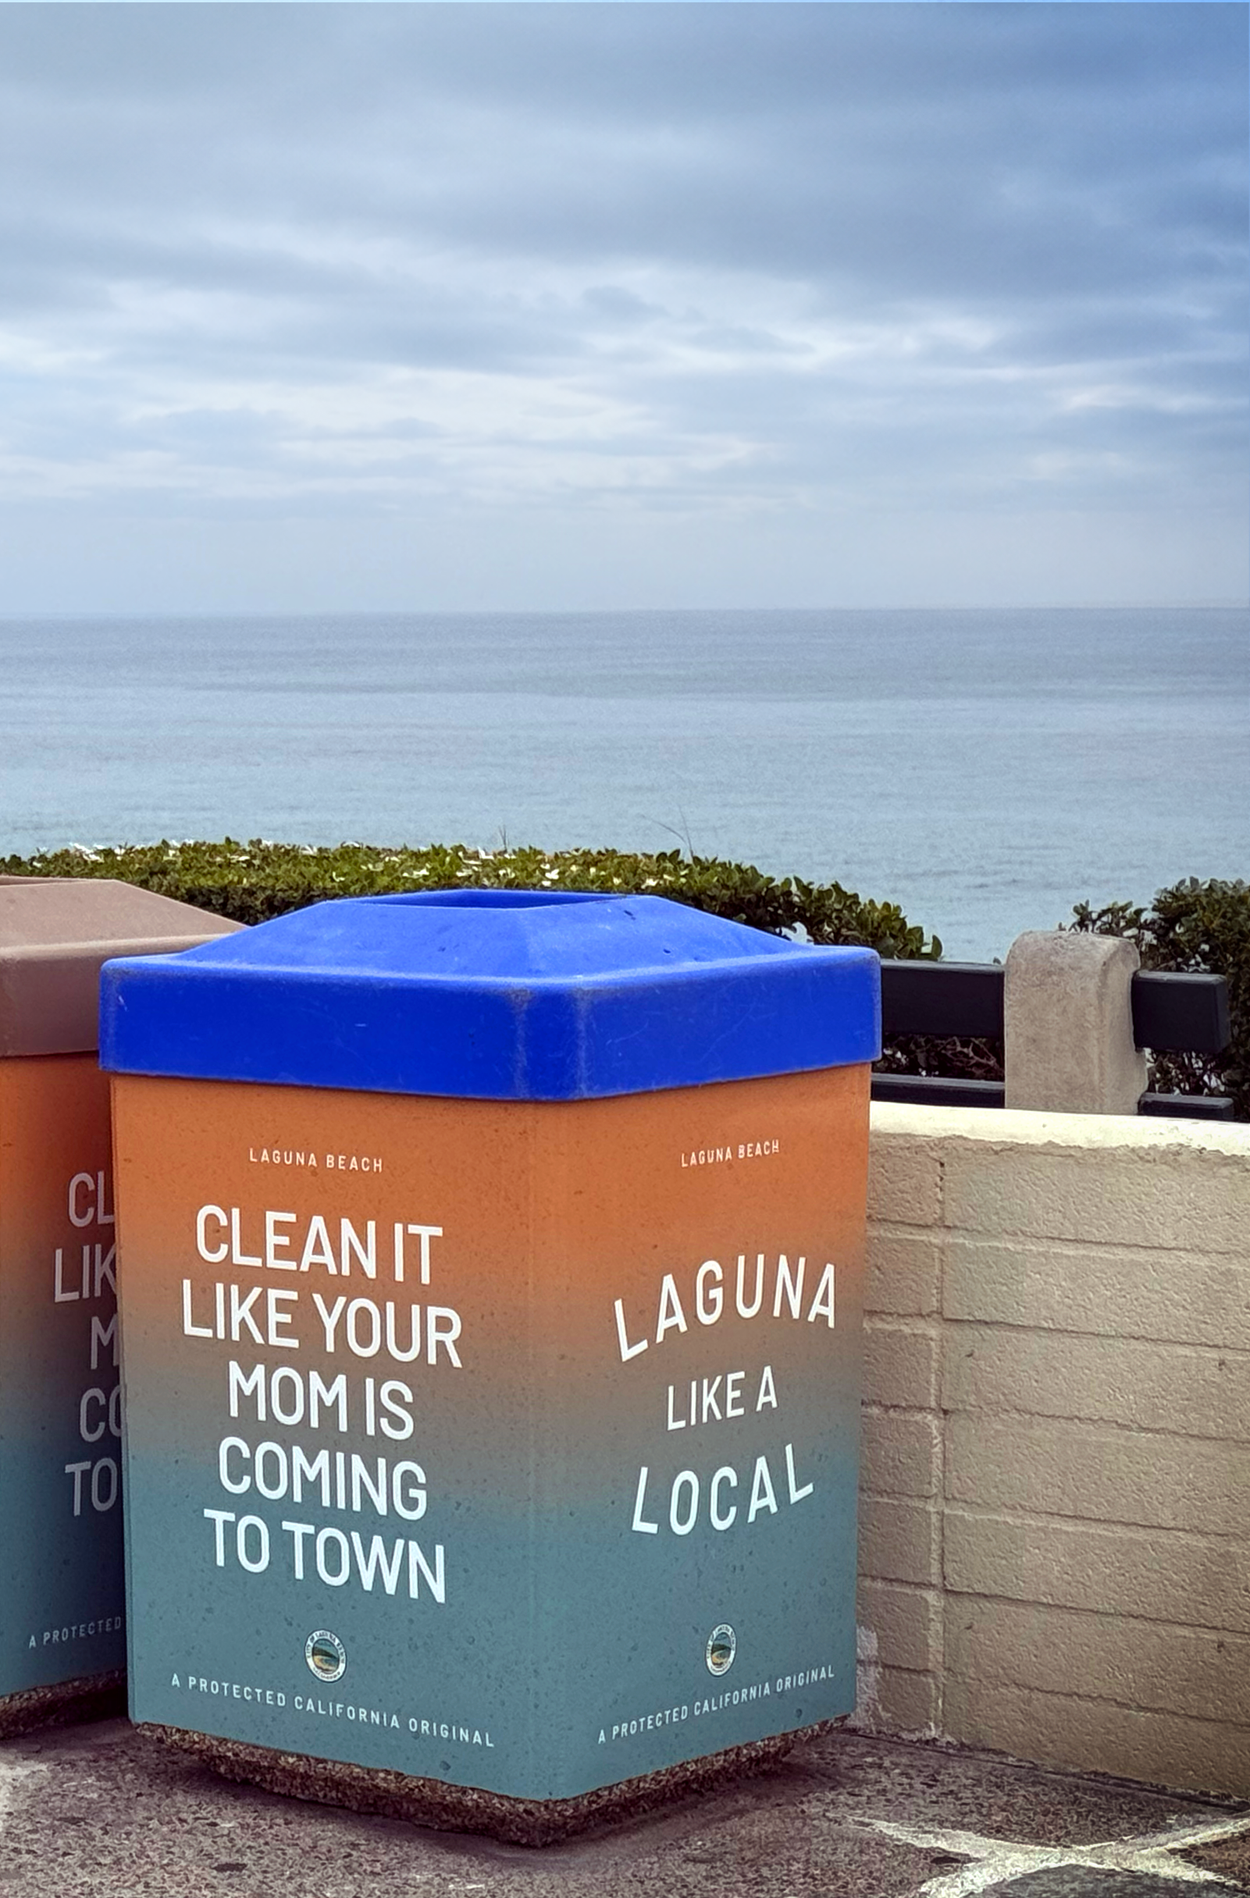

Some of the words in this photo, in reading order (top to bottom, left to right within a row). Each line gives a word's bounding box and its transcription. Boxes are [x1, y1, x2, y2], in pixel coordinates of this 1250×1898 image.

[249, 1147, 318, 1168] LAGUNA
[325, 1153, 383, 1173] BEACH
[681, 1145, 733, 1168] LAGUNA
[737, 1139, 780, 1159] BEACH
[53, 1242, 118, 1304] LIK
[196, 1204, 377, 1280] CLEAN
[393, 1222, 444, 1285] IT
[182, 1278, 300, 1349] LIKE
[311, 1292, 463, 1369] YOUR
[613, 1253, 835, 1363] LAGUNA
[228, 1360, 348, 1433] MOM
[365, 1377, 414, 1441] IS
[667, 1370, 746, 1431] LIKE
[755, 1365, 778, 1412] A
[64, 1456, 119, 1518] TO
[217, 1436, 428, 1522] COMING
[631, 1443, 814, 1536] LOCAL
[203, 1508, 270, 1573] TO
[281, 1520, 447, 1605] TOWN
[28, 1634, 37, 1649] A
[42, 1616, 122, 1646] PROTECTED
[171, 1672, 181, 1688] A
[188, 1675, 286, 1707] PROTECTED
[294, 1695, 401, 1729] CALIFORNIA
[408, 1717, 495, 1748] ORIGINAL
[597, 1728, 606, 1745] A
[611, 1705, 689, 1740] PROTECTED
[693, 1681, 771, 1716] CALIFORNIA
[776, 1664, 835, 1693] ORIGINAL
